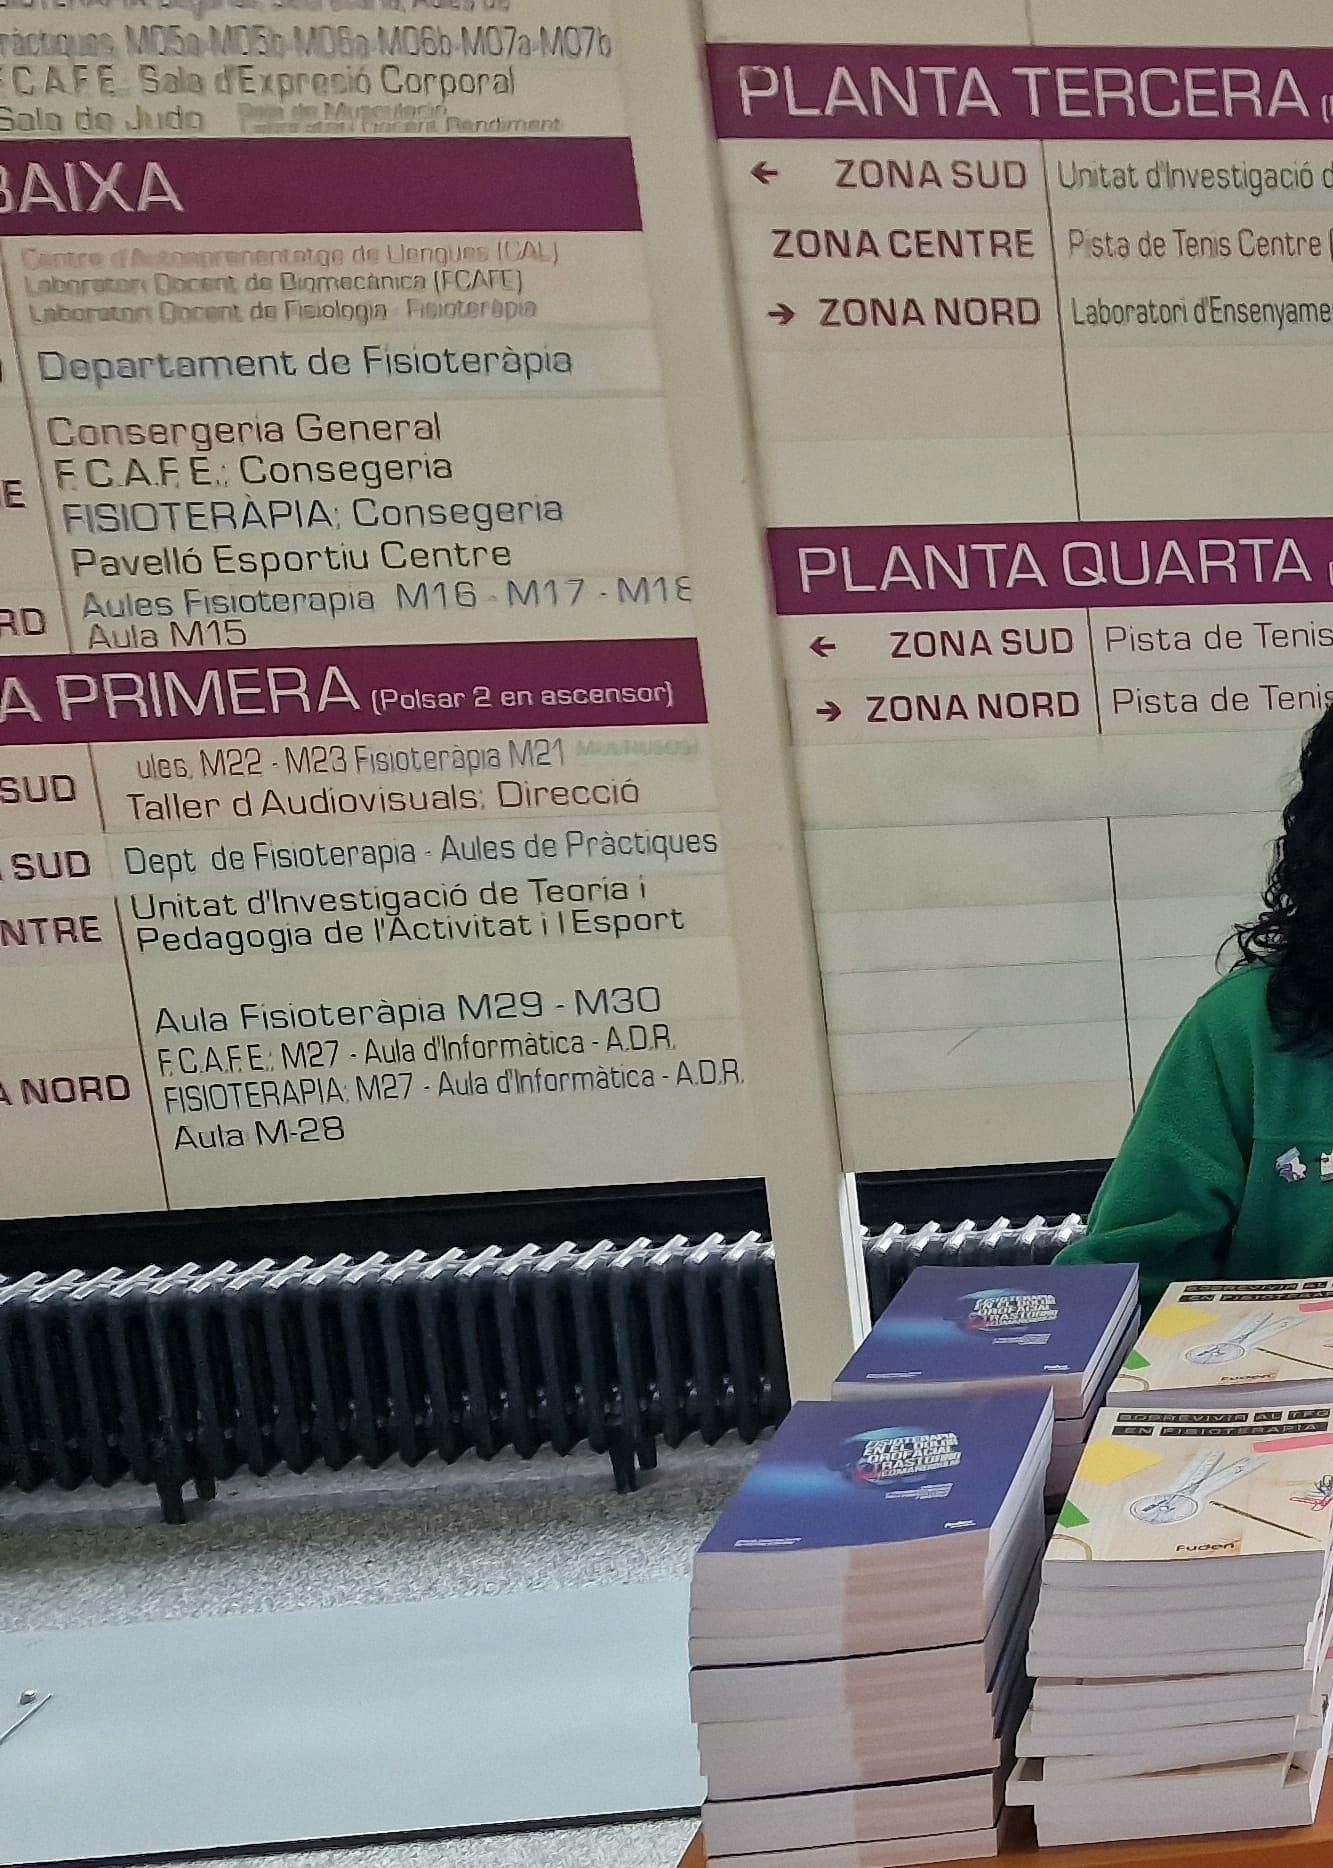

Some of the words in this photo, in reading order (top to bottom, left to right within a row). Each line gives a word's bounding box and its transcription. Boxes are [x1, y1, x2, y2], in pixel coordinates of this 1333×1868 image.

[738, 65, 1001, 118] PLANTA
[1012, 67, 1310, 118] TERCERA
[834, 159, 943, 188] ZONA
[952, 160, 1027, 188] SUD
[1058, 159, 1139, 188] Unitat
[772, 229, 880, 257] ZONA
[889, 229, 1034, 257] CENTRE
[1069, 229, 1130, 257] Pista
[1138, 229, 1166, 257] de
[1173, 229, 1232, 257] Tenis
[1238, 228, 1322, 257] Centre
[819, 298, 928, 327] ZONA
[936, 298, 1041, 326] NORD
[1072, 297, 1188, 326] Laboratori
[37, 348, 297, 391] Departament
[308, 346, 351, 376] de
[363, 344, 574, 381] Fisioteràpia
[47, 414, 285, 451] Consergeria
[297, 411, 441, 442] General
[240, 452, 453, 489] Consegeria
[352, 494, 563, 531] Consegeria
[71, 547, 203, 577] Pavelló
[214, 542, 370, 582] Esportiu
[381, 540, 512, 570] Centre
[798, 542, 1048, 593] PLANTA
[1062, 538, 1313, 589] QUARTA
[84, 590, 174, 619] Aules
[396, 581, 478, 610] M16
[508, 578, 585, 607] M17
[89, 623, 159, 650] Aula
[170, 618, 248, 648] M15
[890, 631, 993, 659] ZONA
[1001, 628, 1073, 656] SUD
[1106, 625, 1190, 653] Pista
[1204, 624, 1243, 651] de
[56, 665, 361, 723] PRIMERA
[371, 688, 466, 715] (Polsar
[473, 686, 492, 708] 2
[501, 689, 534, 707] en
[541, 681, 673, 709] ascensor)
[866, 695, 969, 724] ZONA
[979, 691, 1080, 720] NORD
[1114, 688, 1198, 715] Pista
[1211, 686, 1250, 713] de
[200, 747, 264, 778] M22
[286, 744, 348, 776] M23
[509, 737, 565, 768] M21
[127, 792, 221, 822] Taller
[498, 779, 640, 808] Direcció
[11, 850, 92, 881] SUD
[211, 844, 245, 872] de
[441, 834, 516, 863] Aules
[525, 833, 557, 859] de
[566, 830, 719, 863] Pràctiques
[131, 892, 238, 921] Unitat
[248, 882, 467, 917] d'Investigació
[480, 881, 519, 906] de
[528, 876, 628, 906] Teoria
[639, 874, 647, 900] i
[137, 924, 312, 955] Pedagogia
[325, 920, 363, 945] de
[374, 914, 533, 943] l'Activitat
[156, 1006, 228, 1035] Aula
[241, 997, 445, 1032] Fisioteràpia
[458, 991, 543, 1021] M29
[575, 986, 661, 1017] M30
[281, 1039, 339, 1069] M27
[365, 1036, 416, 1066] Aula
[424, 1031, 585, 1061] d'Informàtica
[606, 1023, 676, 1052] A.D.R.
[20, 1074, 131, 1105] NORD
[356, 1071, 413, 1102] M27
[439, 1069, 489, 1098] Aula
[497, 1064, 655, 1095] d'Informàtica
[676, 1058, 745, 1087] A.D.R.
[175, 1124, 245, 1151] Aula
[255, 1115, 346, 1147] M-28
[1123, 1426, 1152, 1435] EN
[1162, 1423, 1318, 1435] FISIOTERAPIA
[1255, 1411, 1281, 1421] AL
